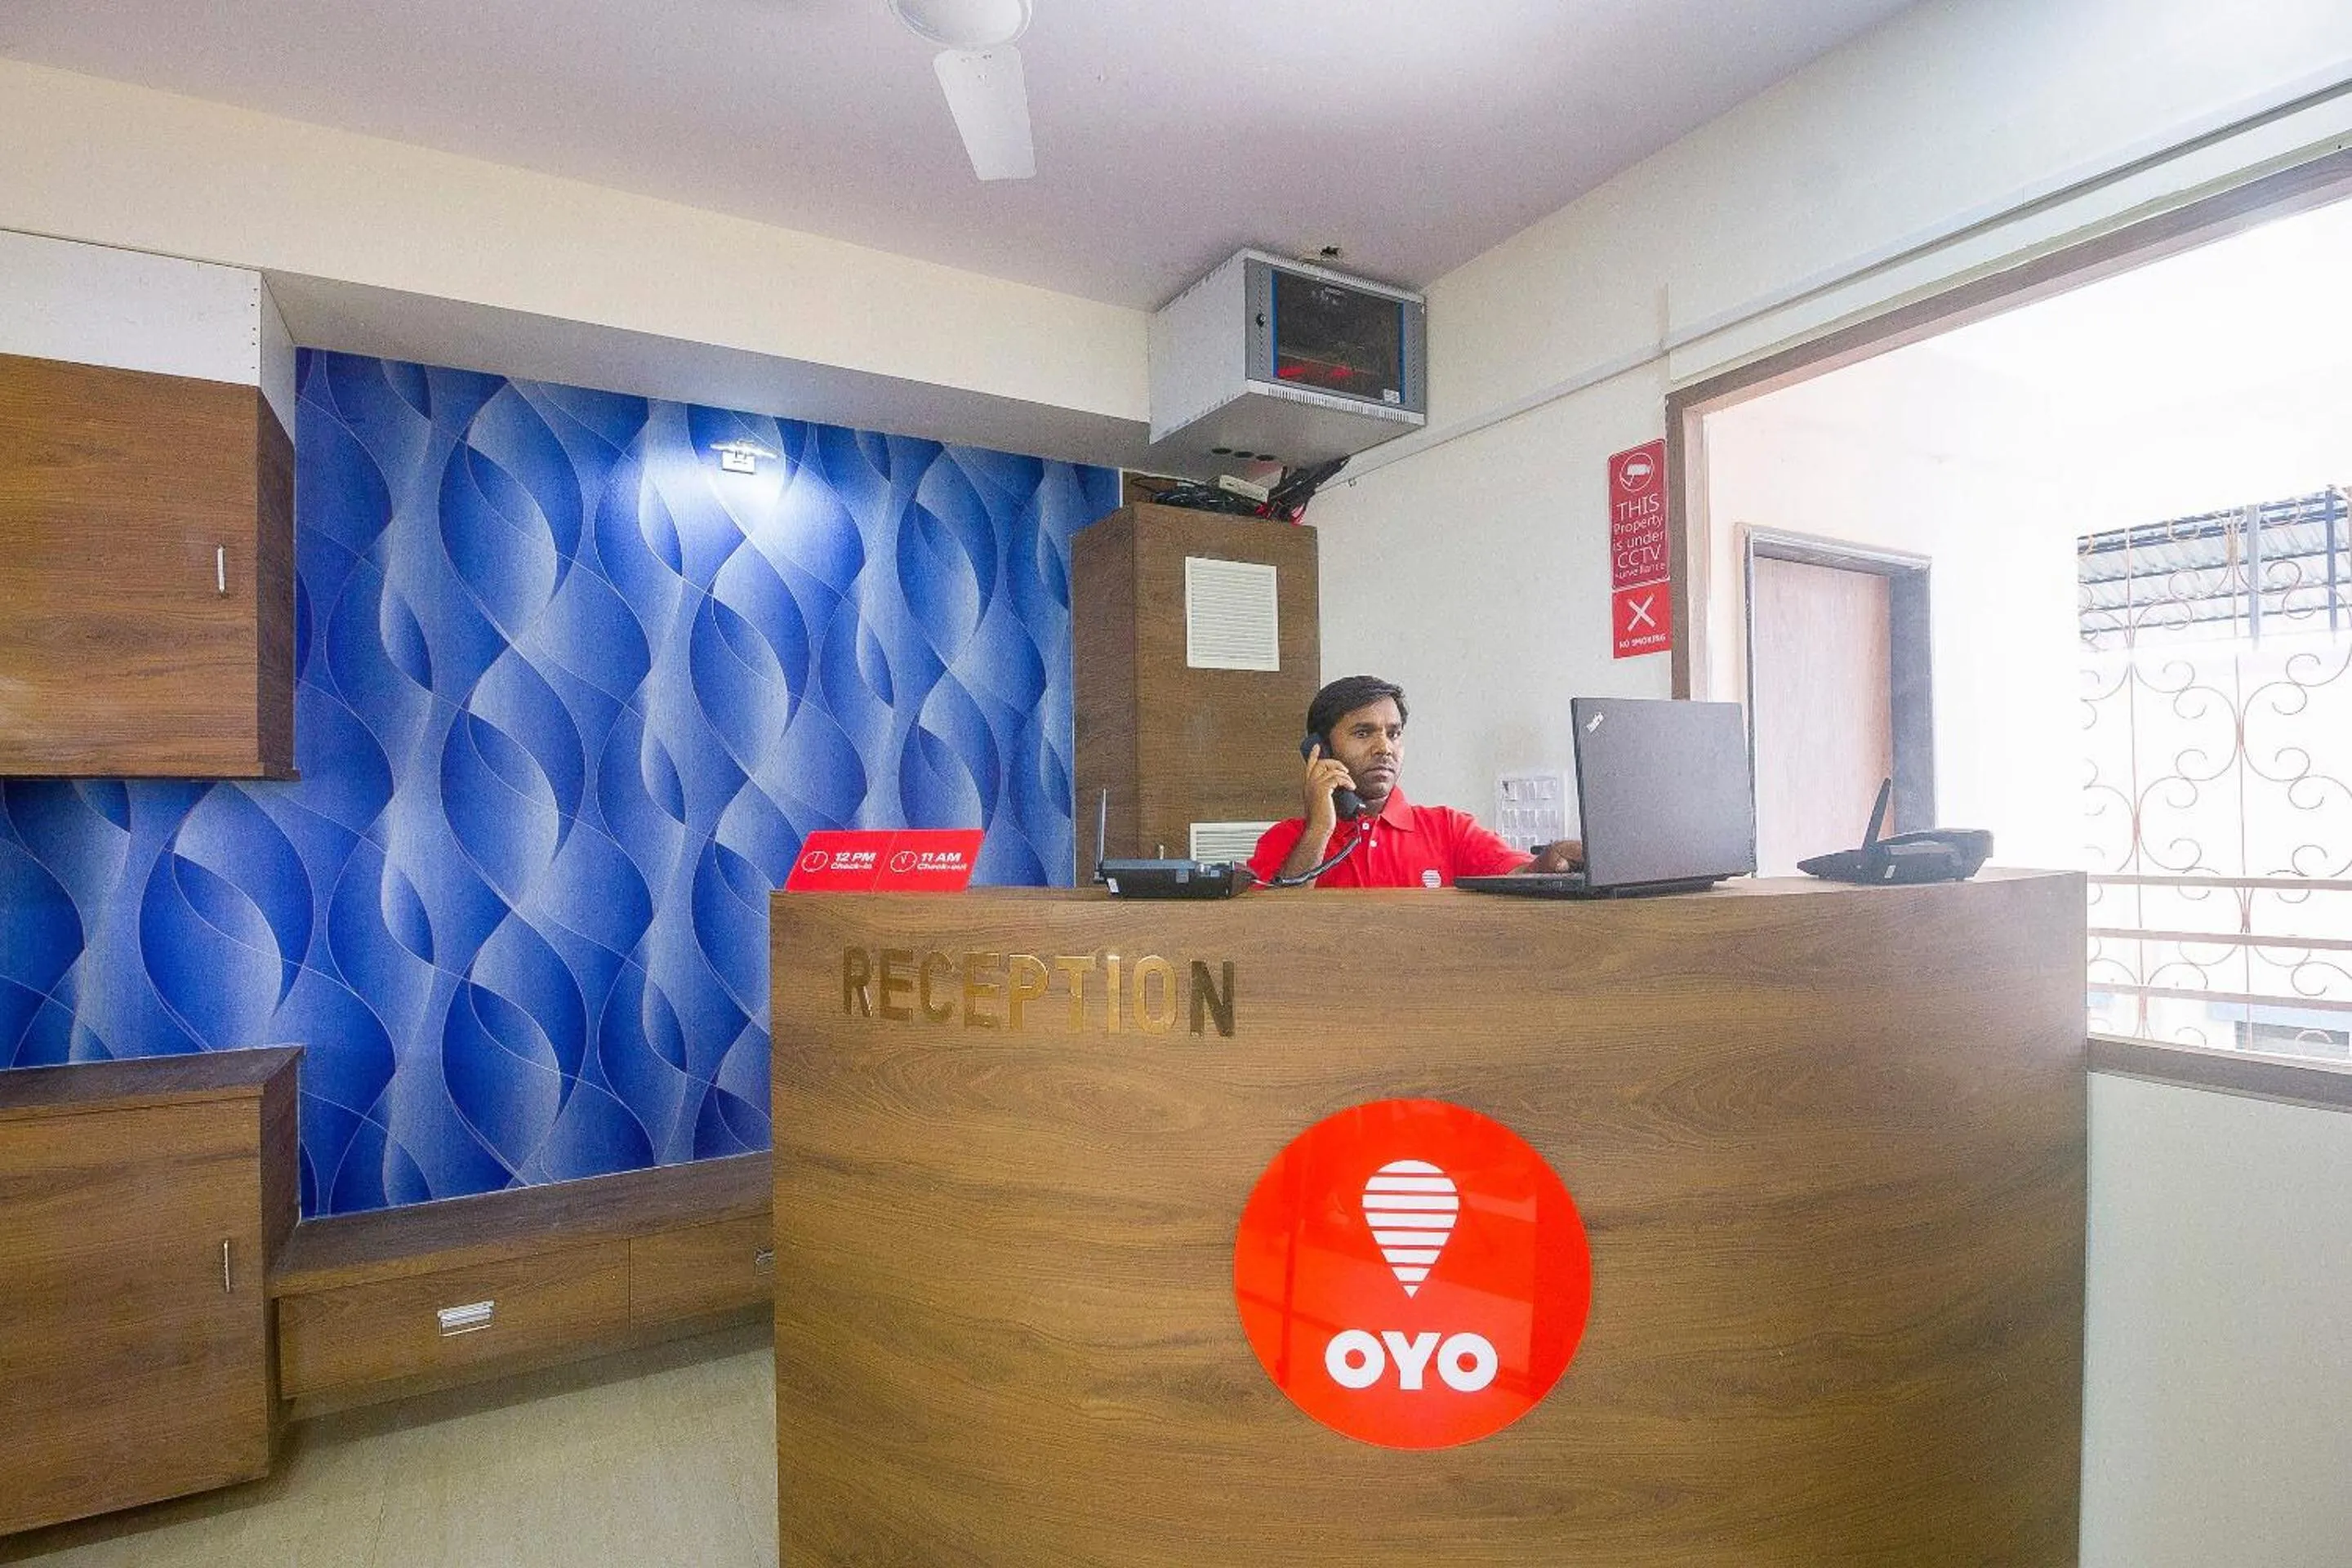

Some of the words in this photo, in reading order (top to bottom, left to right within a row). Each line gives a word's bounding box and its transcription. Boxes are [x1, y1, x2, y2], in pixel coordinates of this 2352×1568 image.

[1616, 493, 1659, 521] THIS
[1613, 539, 1623, 551] is
[1627, 530, 1664, 548] under
[1618, 544, 1661, 568] CCTV
[1619, 639, 1630, 649] NO
[1631, 633, 1666, 647] SMOKING
[835, 852, 850, 862] 12
[852, 852, 876, 862] PM
[921, 852, 934, 862] 11
[935, 852, 962, 862] AM
[843, 945, 1236, 1038] RECEPTION
[1325, 1329, 1499, 1392] OYO
